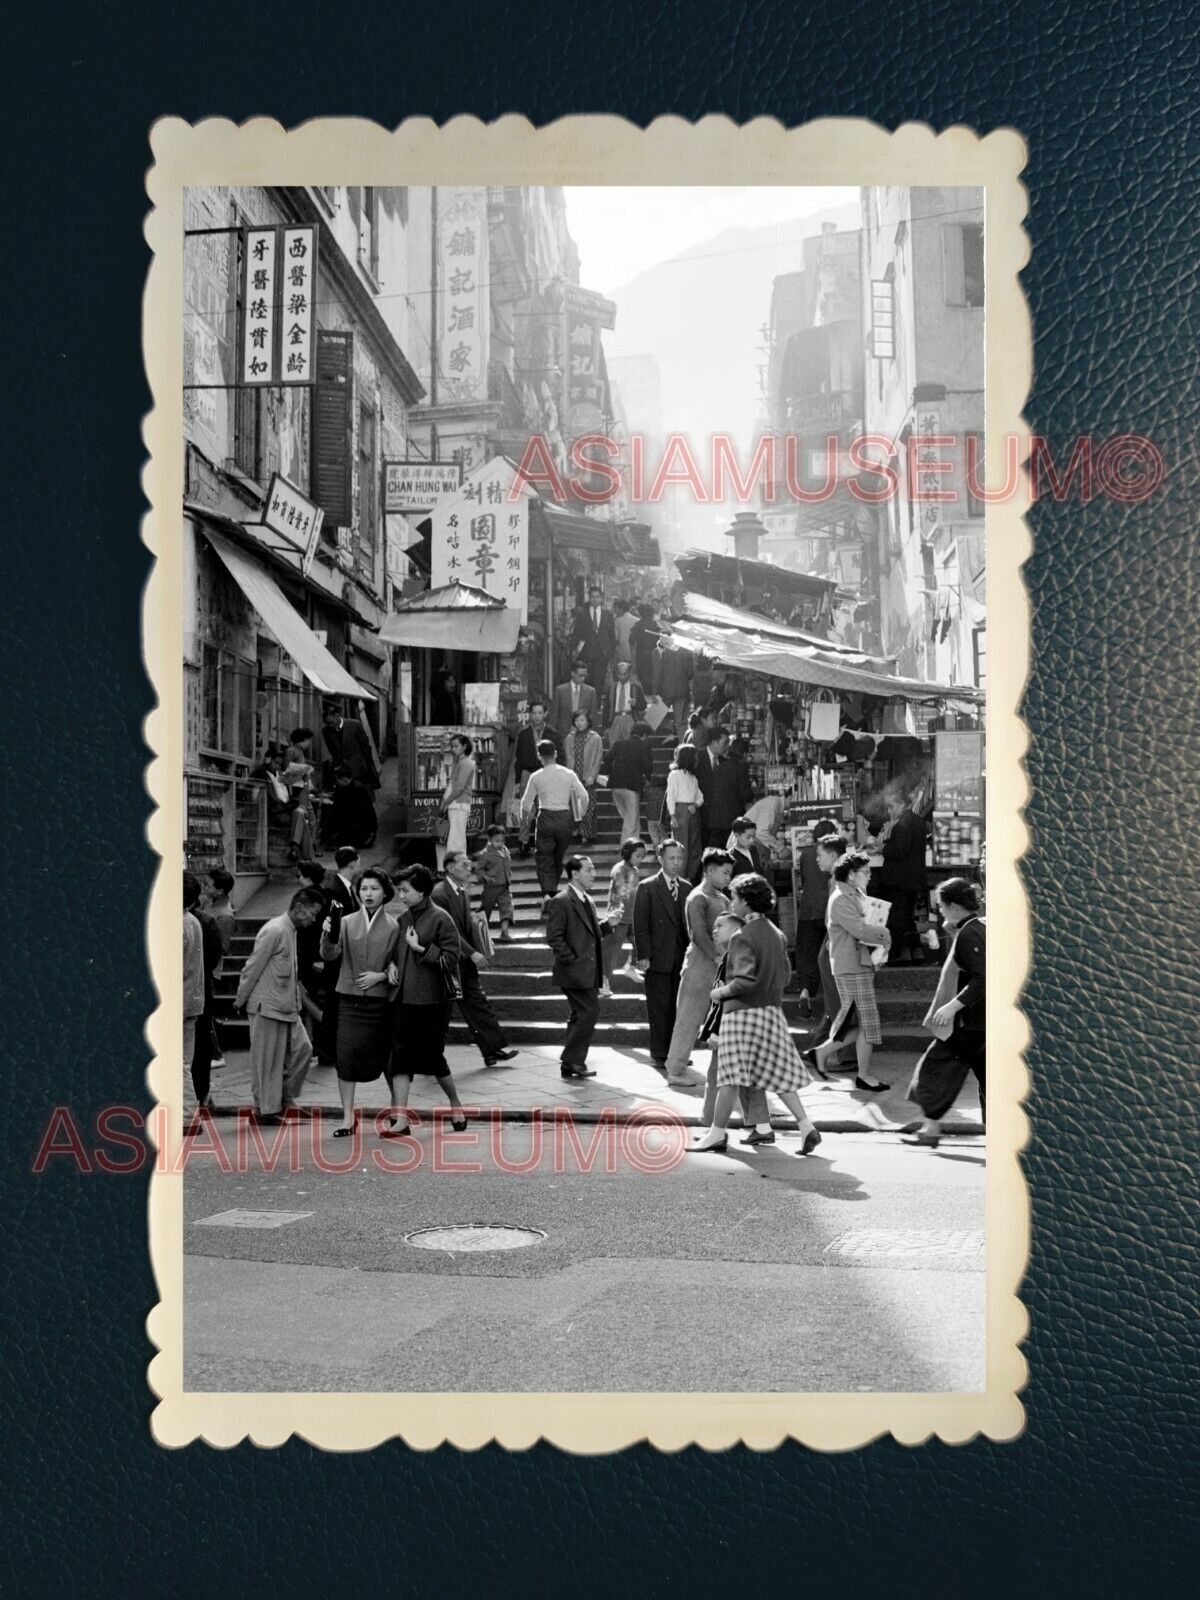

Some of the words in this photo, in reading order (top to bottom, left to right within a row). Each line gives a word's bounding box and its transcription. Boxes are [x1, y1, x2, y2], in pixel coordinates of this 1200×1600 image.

[287, 237, 307, 374] 西醫梁金齡
[447, 227, 476, 373] 鏞記酒家
[387, 480, 413, 493] CHAN
[415, 480, 440, 492] HUNG
[442, 480, 457, 492] WAI
[406, 496, 438, 504] TAILOR
[414, 797, 440, 807] IVORY
